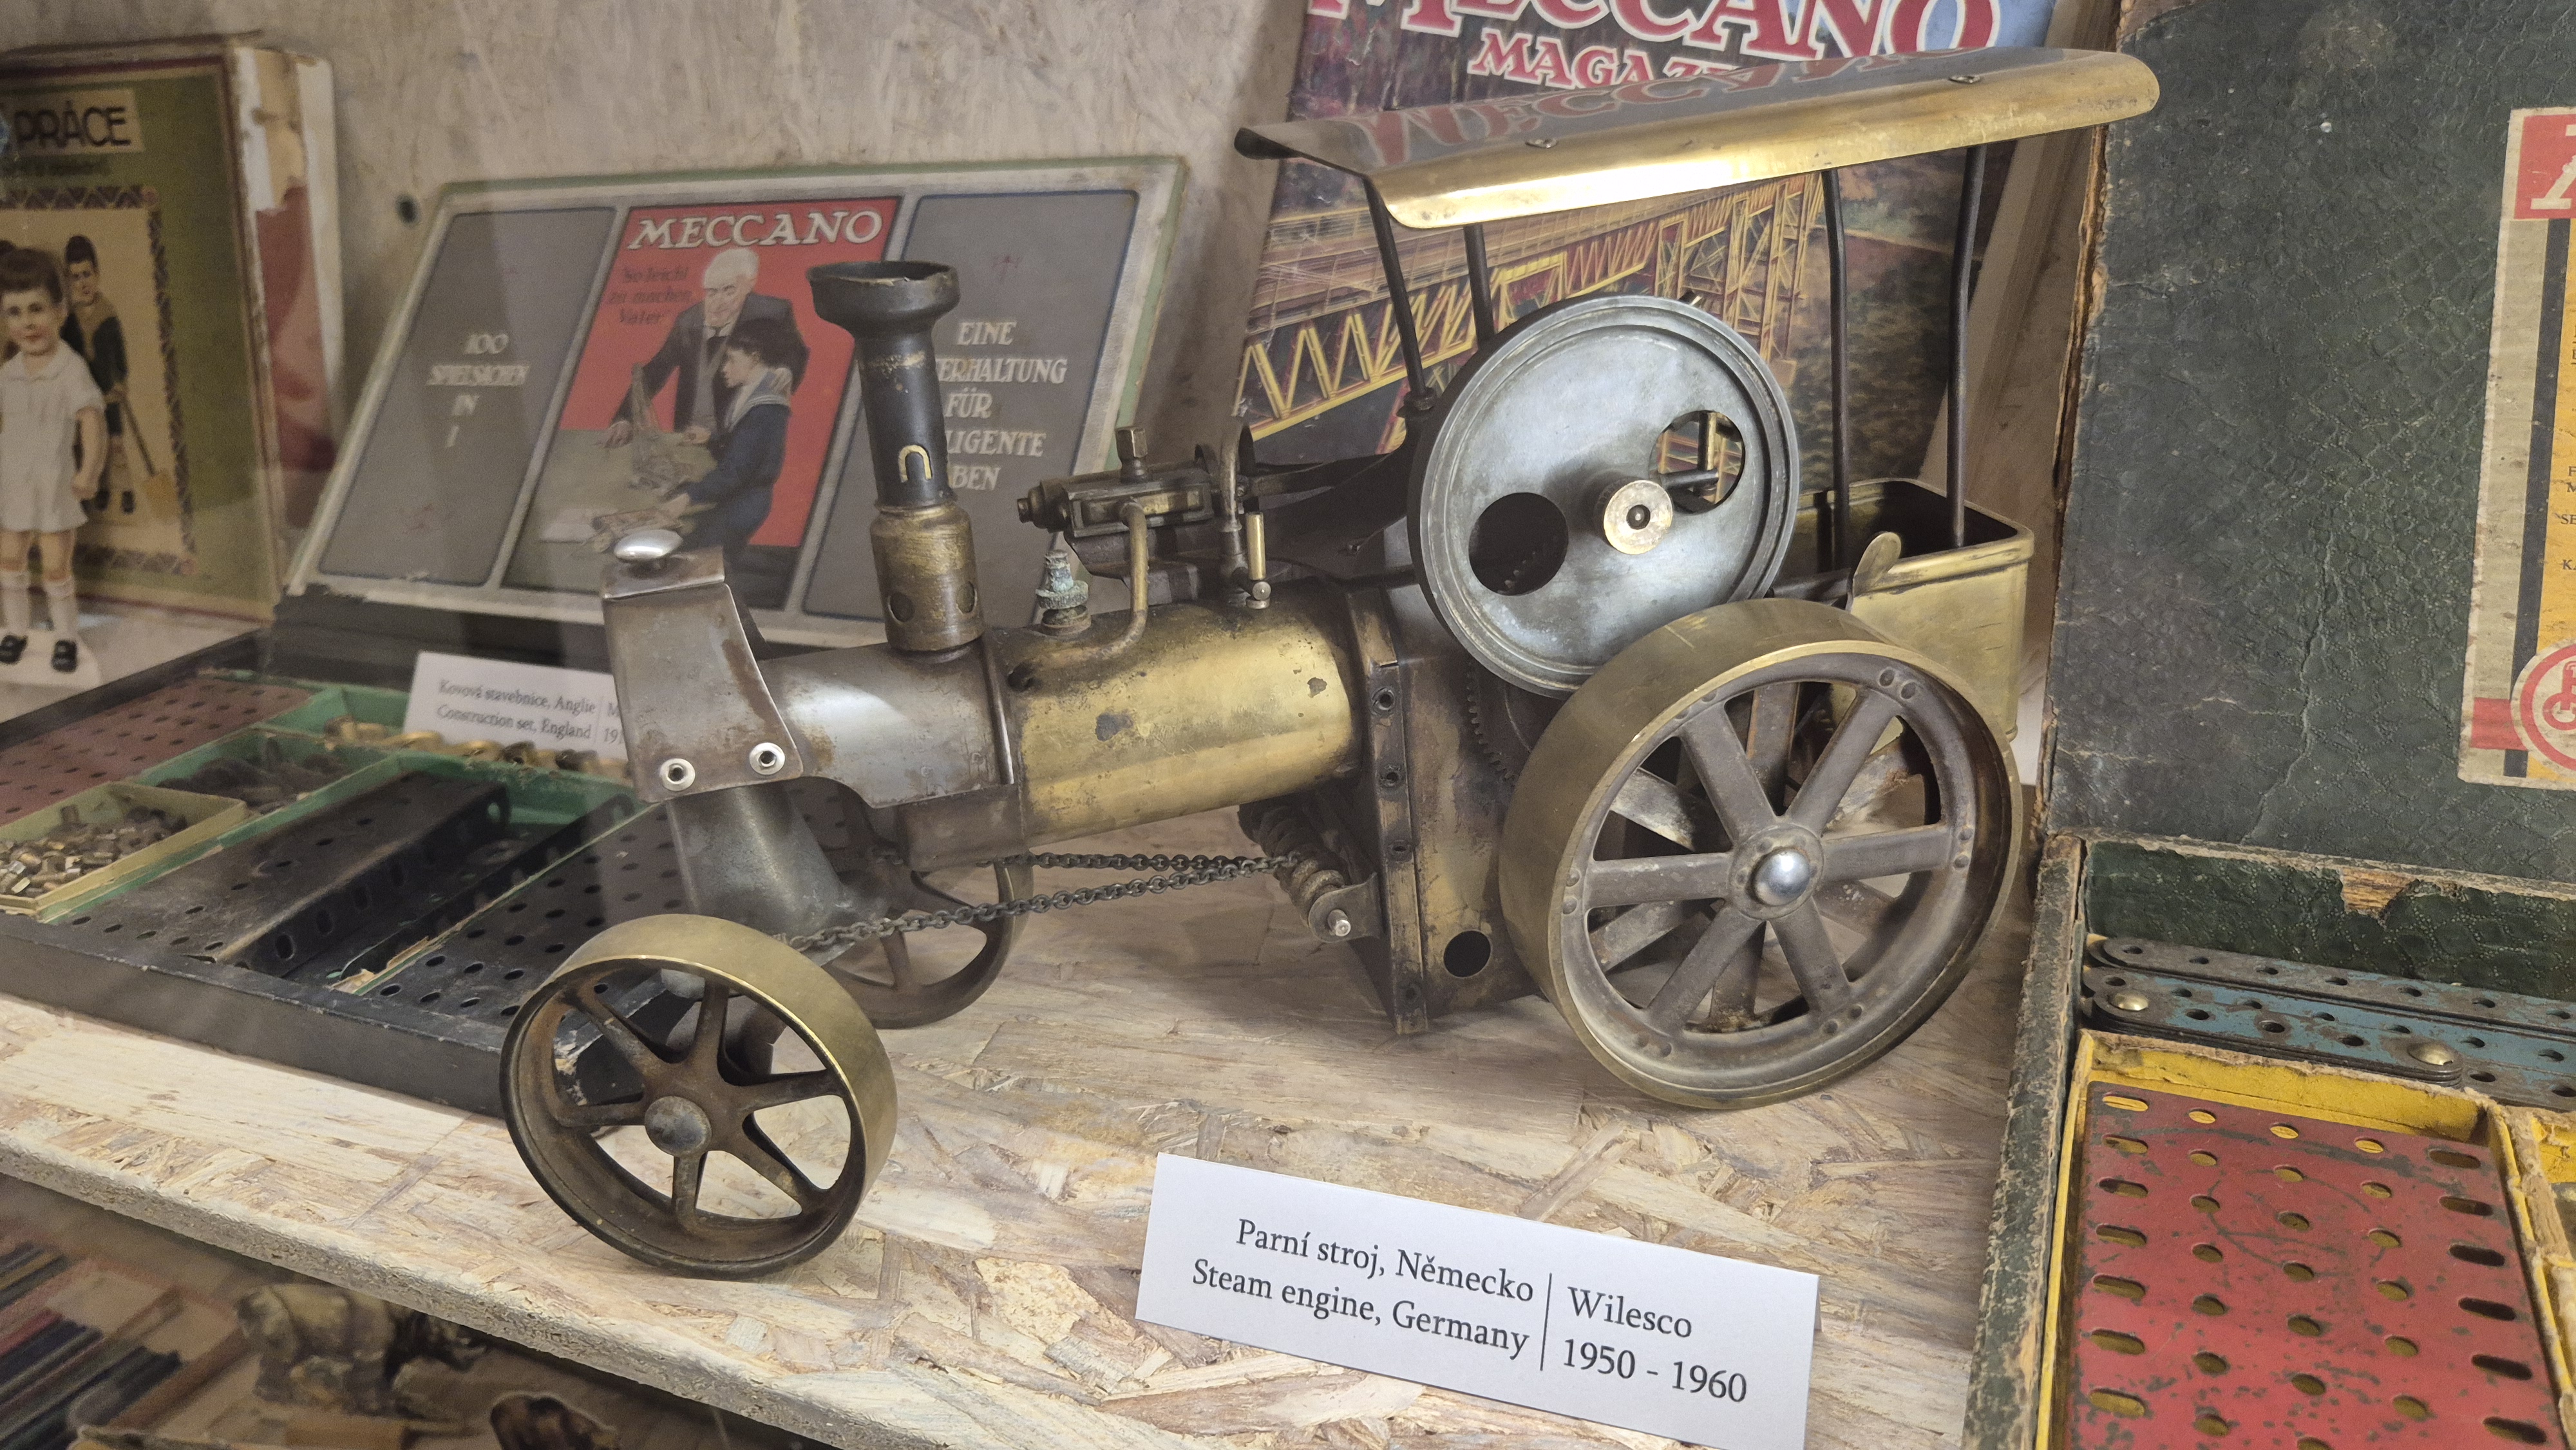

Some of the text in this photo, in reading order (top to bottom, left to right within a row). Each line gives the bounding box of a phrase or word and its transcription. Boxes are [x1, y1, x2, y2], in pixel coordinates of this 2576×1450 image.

[1467, 27, 1741, 89] MAGA
[627, 210, 883, 250] MECCANO
[957, 321, 1018, 346] EINE
[935, 358, 1068, 384] ERHALTUNG
[943, 388, 993, 419] FÜR
[949, 465, 1001, 491] BEN
[554, 695, 596, 717] Anglie
[541, 718, 591, 739] England
[604, 728, 623, 744] 19
[1236, 1218, 1534, 1302] Parní stroj, Německo
[1192, 1257, 1530, 1361] Steam engine, Germany
[1567, 1286, 1692, 1338] Wilesco
[1563, 1338, 1636, 1379] 1950
[1672, 1361, 1747, 1403] 1960
